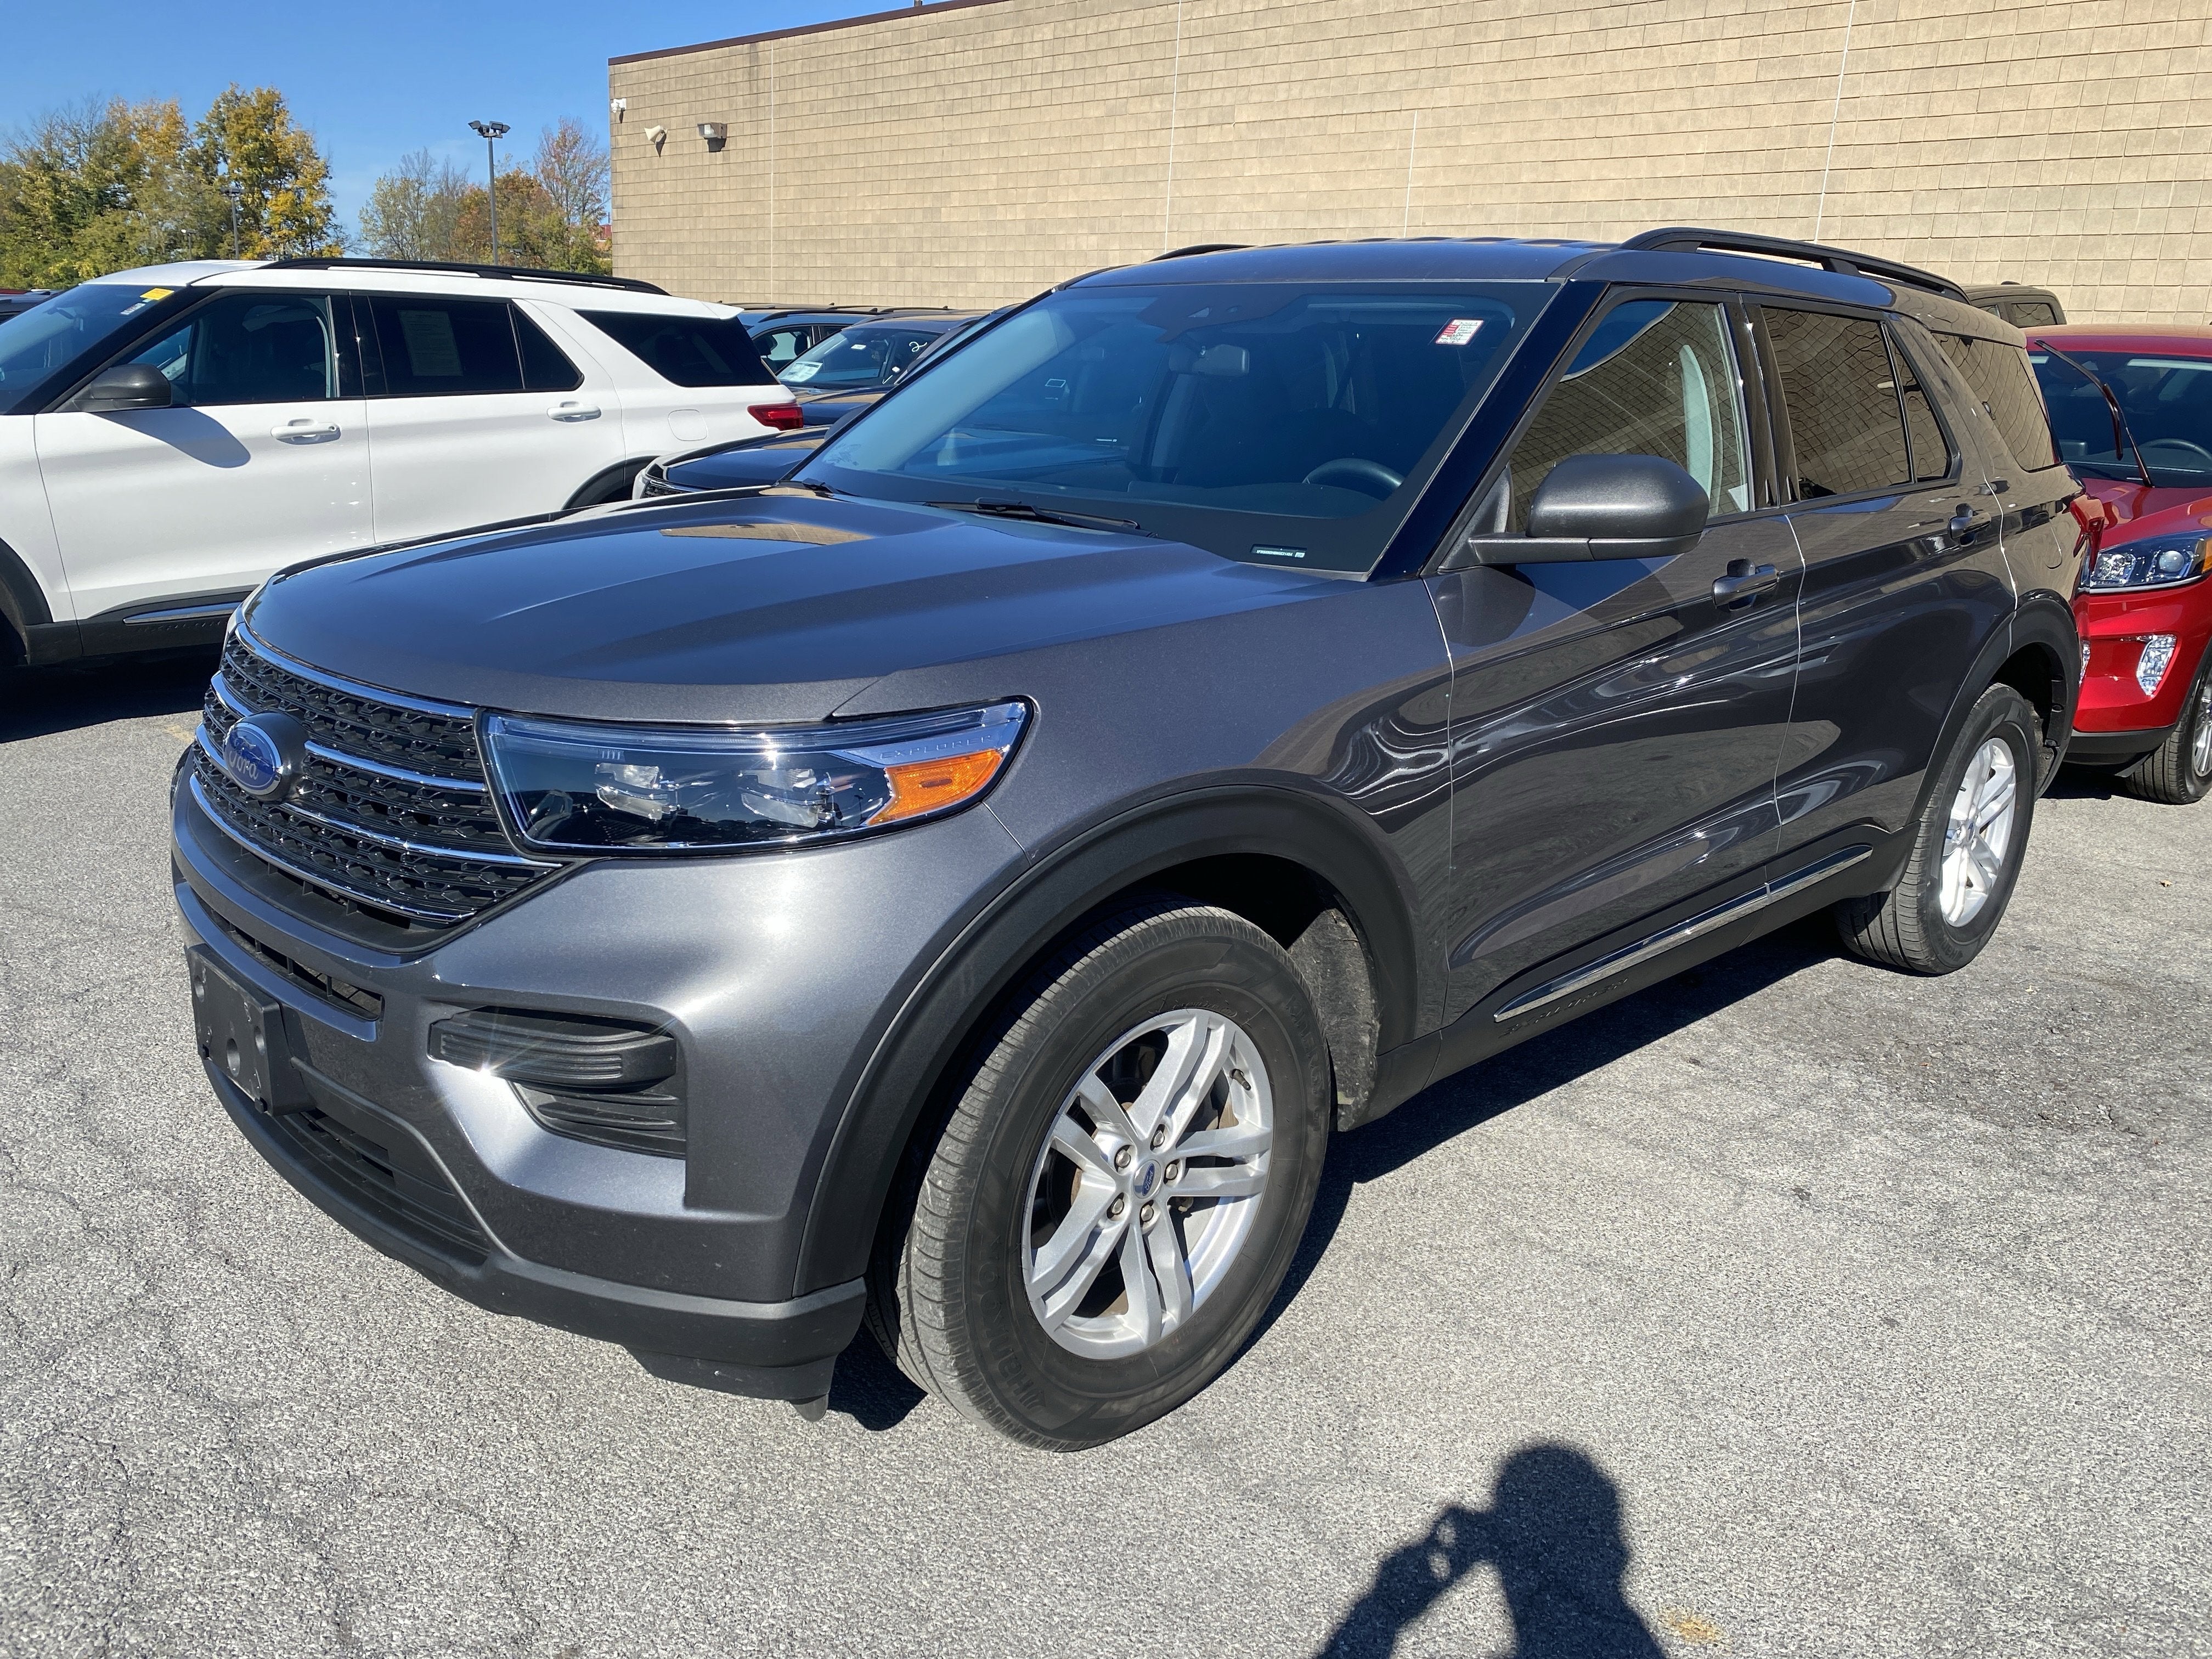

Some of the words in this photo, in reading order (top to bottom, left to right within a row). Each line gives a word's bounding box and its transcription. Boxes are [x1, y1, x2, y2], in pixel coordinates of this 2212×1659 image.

[227, 732, 272, 783] Ford
[880, 734, 993, 760] EXPLORER
[1143, 1167, 1154, 1192] Ford
